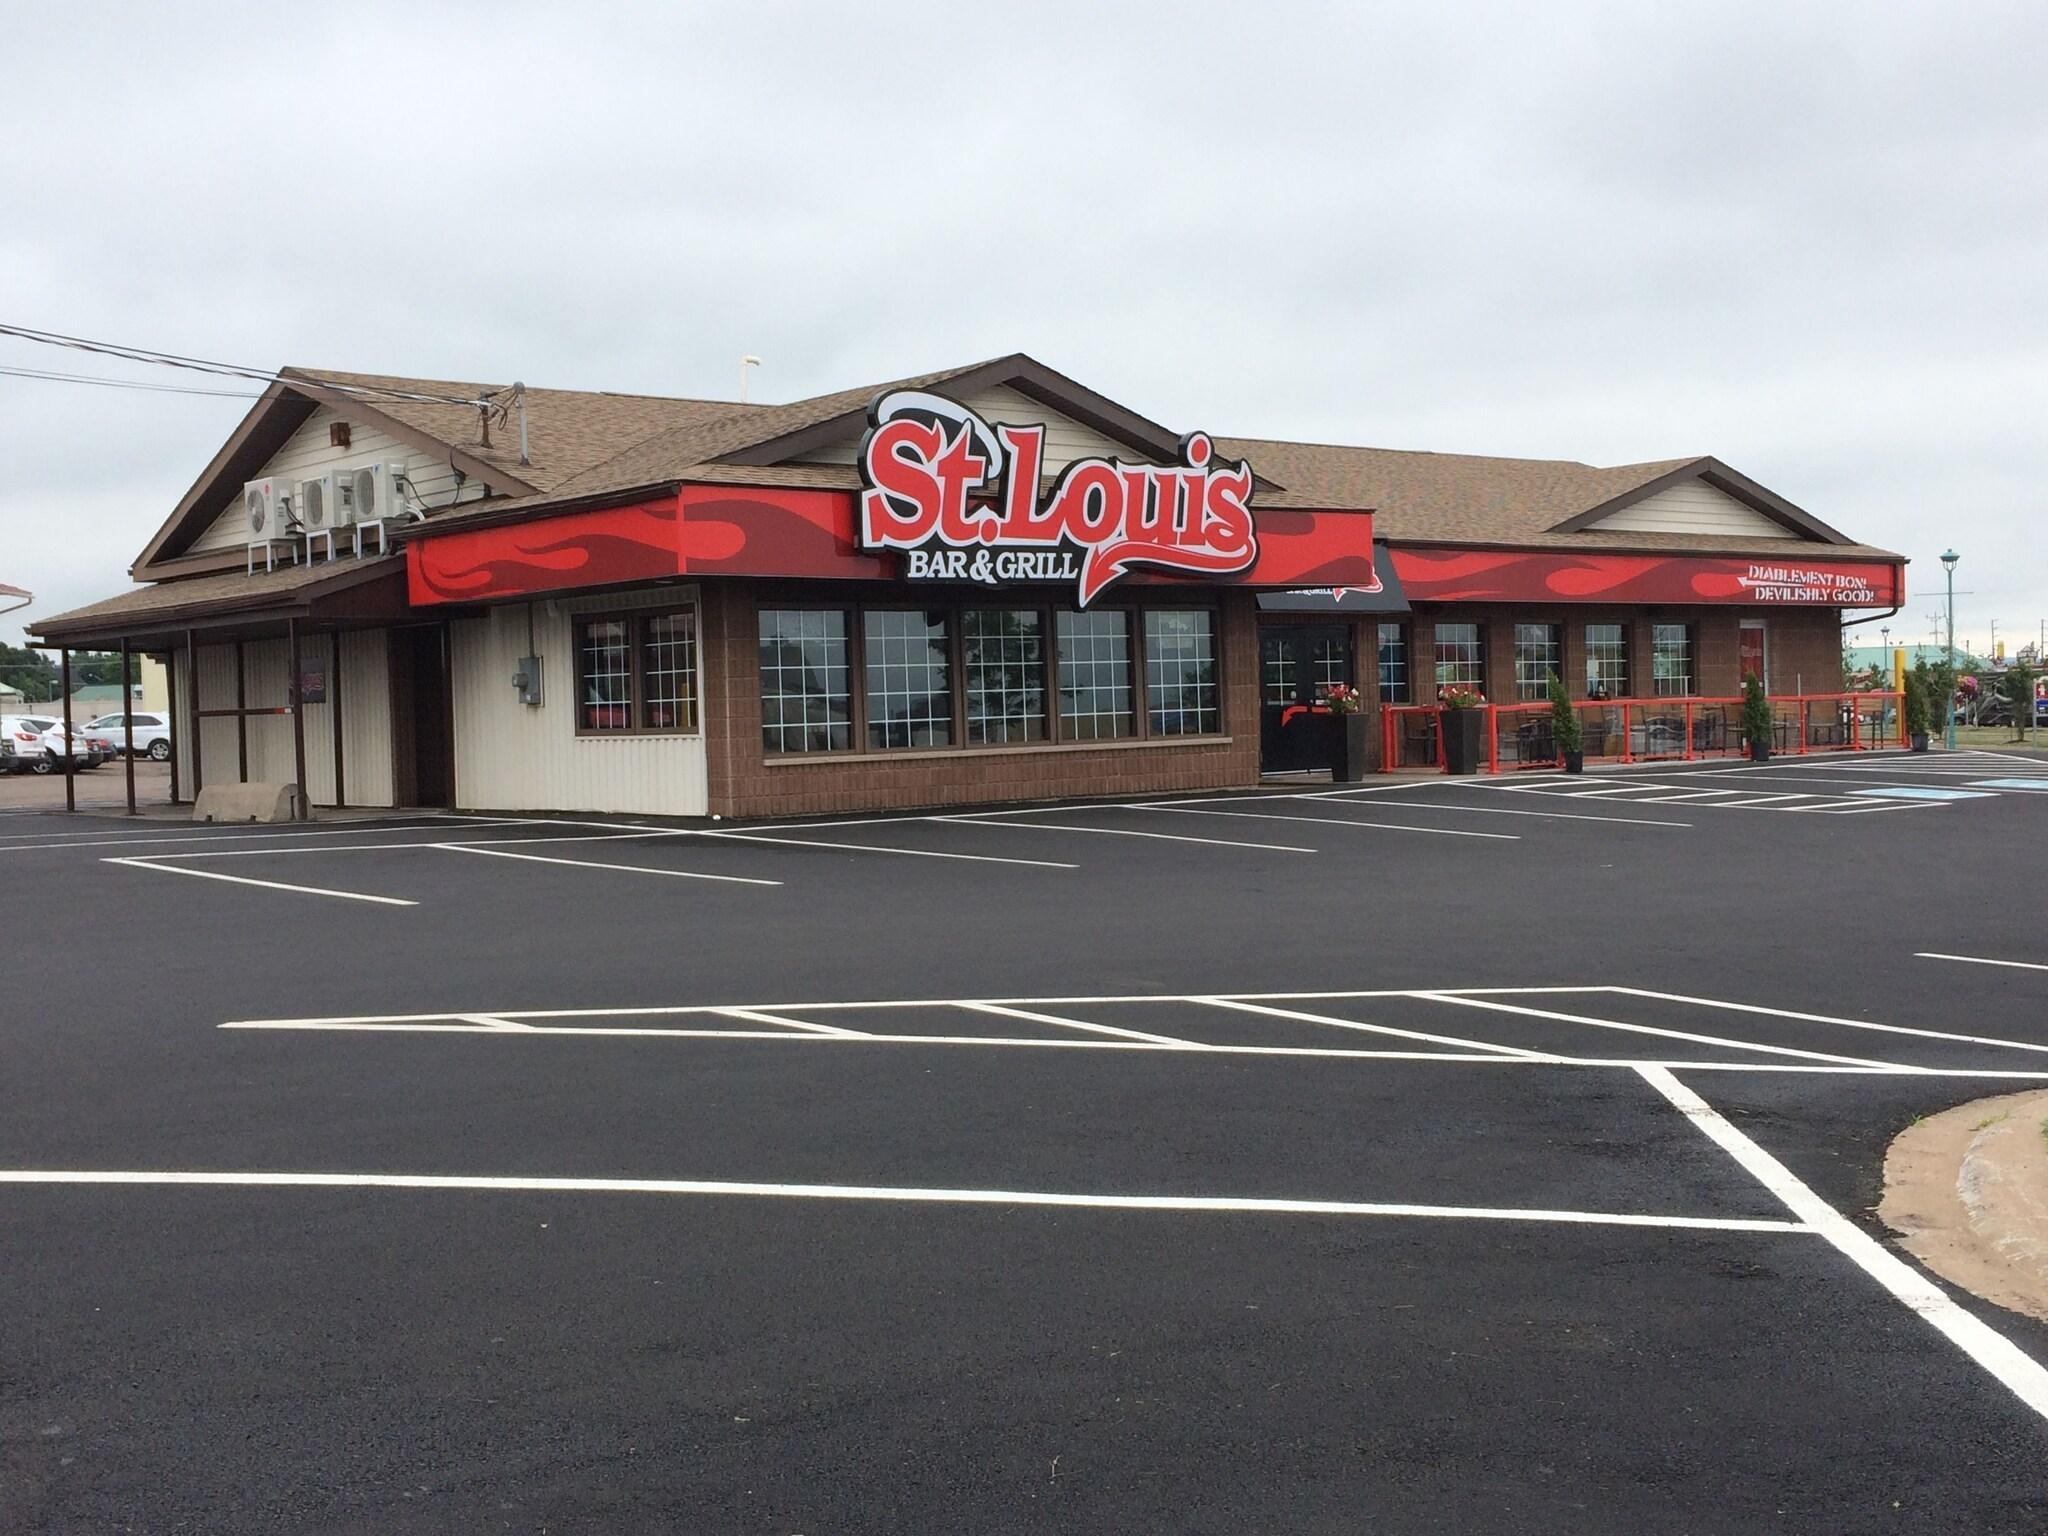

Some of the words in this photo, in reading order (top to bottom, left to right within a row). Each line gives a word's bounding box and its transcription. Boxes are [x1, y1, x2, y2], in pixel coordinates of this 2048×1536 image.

[1749, 565, 1834, 586] DIABLEMENT
[1835, 577, 1867, 589] BON!
[1755, 587, 1830, 601] DEVILISHLY
[1832, 589, 1874, 602] GOOD!
